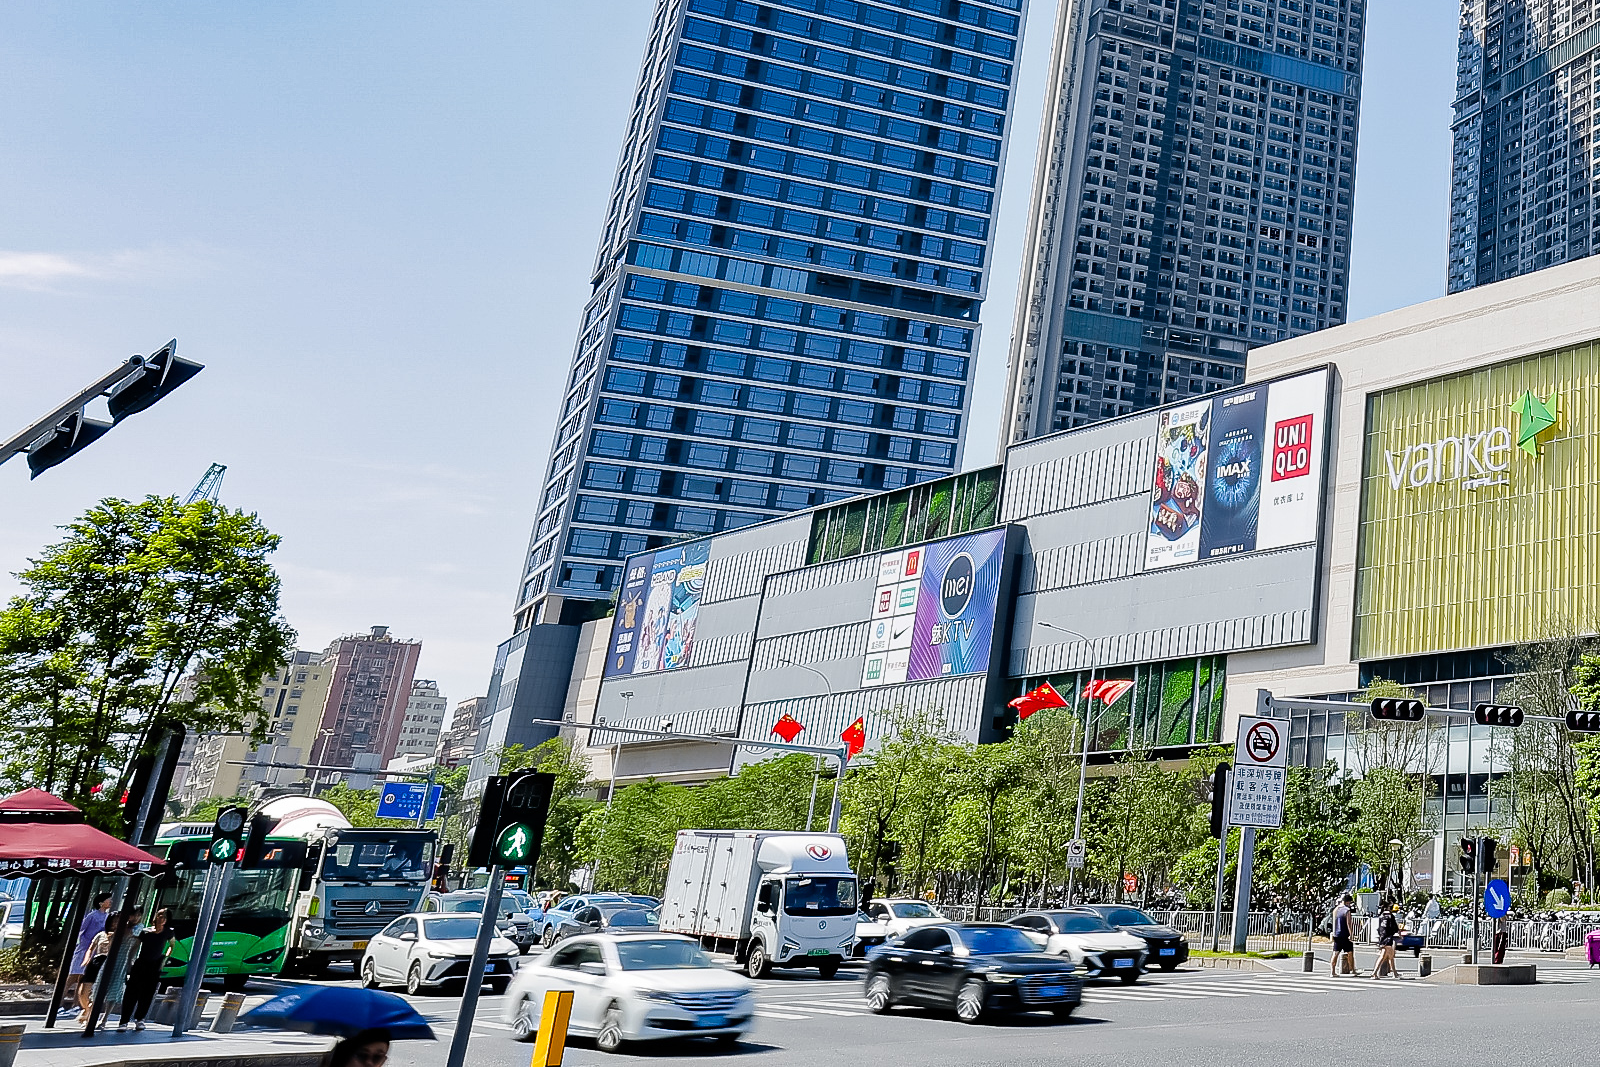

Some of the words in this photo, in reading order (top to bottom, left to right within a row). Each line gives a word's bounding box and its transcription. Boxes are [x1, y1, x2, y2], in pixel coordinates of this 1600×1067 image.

[1277, 422, 1307, 449] UNI
[1216, 459, 1251, 478] IMAX
[1275, 447, 1307, 477] QLO
[1384, 425, 1512, 491] vanke
[944, 570, 970, 599] mei
[1236, 780, 1281, 793] 载客汽车
[1237, 768, 1282, 781] 非深圳号牌
